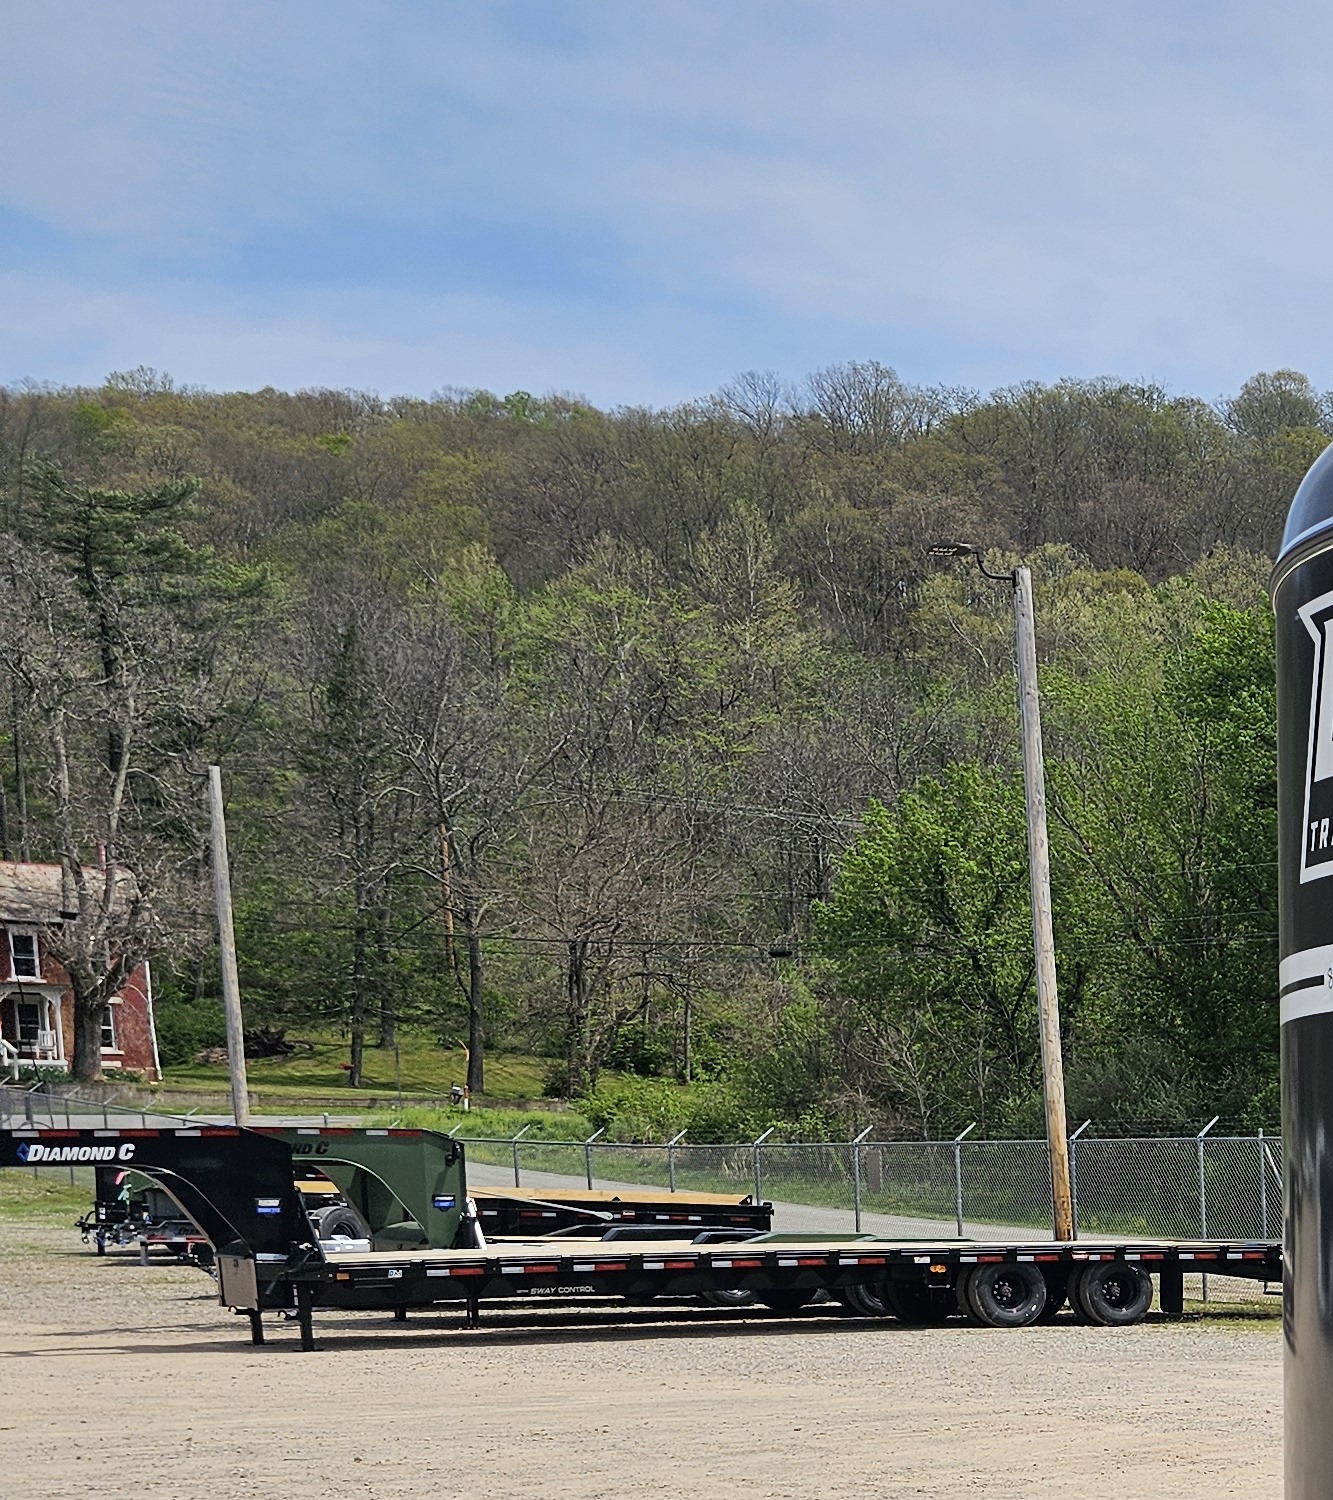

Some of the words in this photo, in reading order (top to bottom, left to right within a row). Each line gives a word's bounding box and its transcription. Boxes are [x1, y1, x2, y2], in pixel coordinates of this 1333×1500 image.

[27, 1144, 116, 1161] DIAMOND
[118, 1143, 135, 1161] C
[315, 1140, 329, 1155] C
[530, 1287, 557, 1295] SWAY
[558, 1285, 596, 1294] CONTROL
